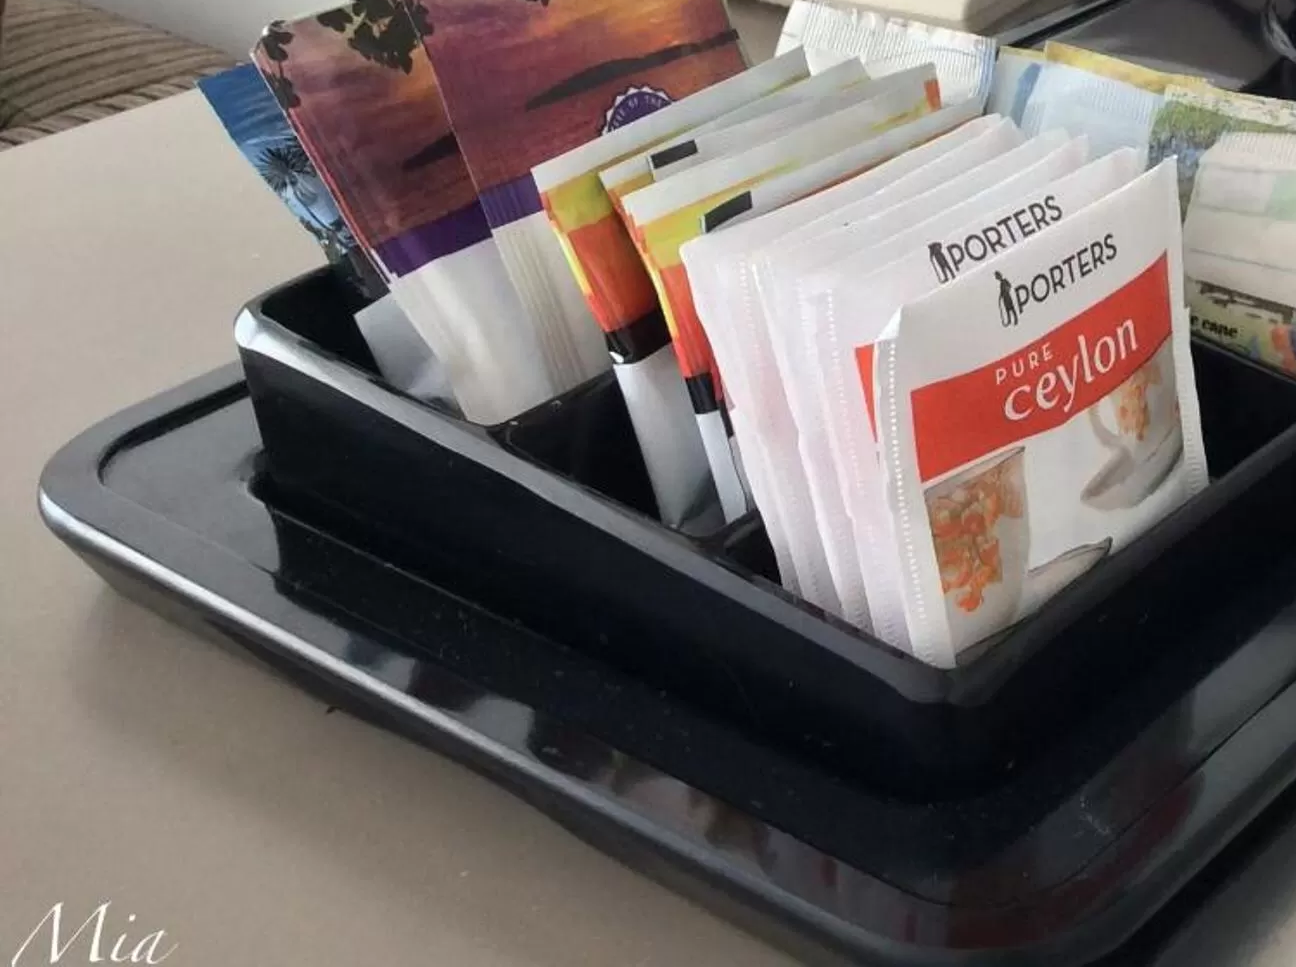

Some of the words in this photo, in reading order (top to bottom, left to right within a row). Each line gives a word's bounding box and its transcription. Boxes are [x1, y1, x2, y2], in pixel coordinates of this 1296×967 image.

[946, 195, 1063, 273] PORTERS
[1014, 233, 1118, 315] PORTERS
[994, 343, 1055, 385] PURE
[1004, 318, 1138, 421] ceylon
